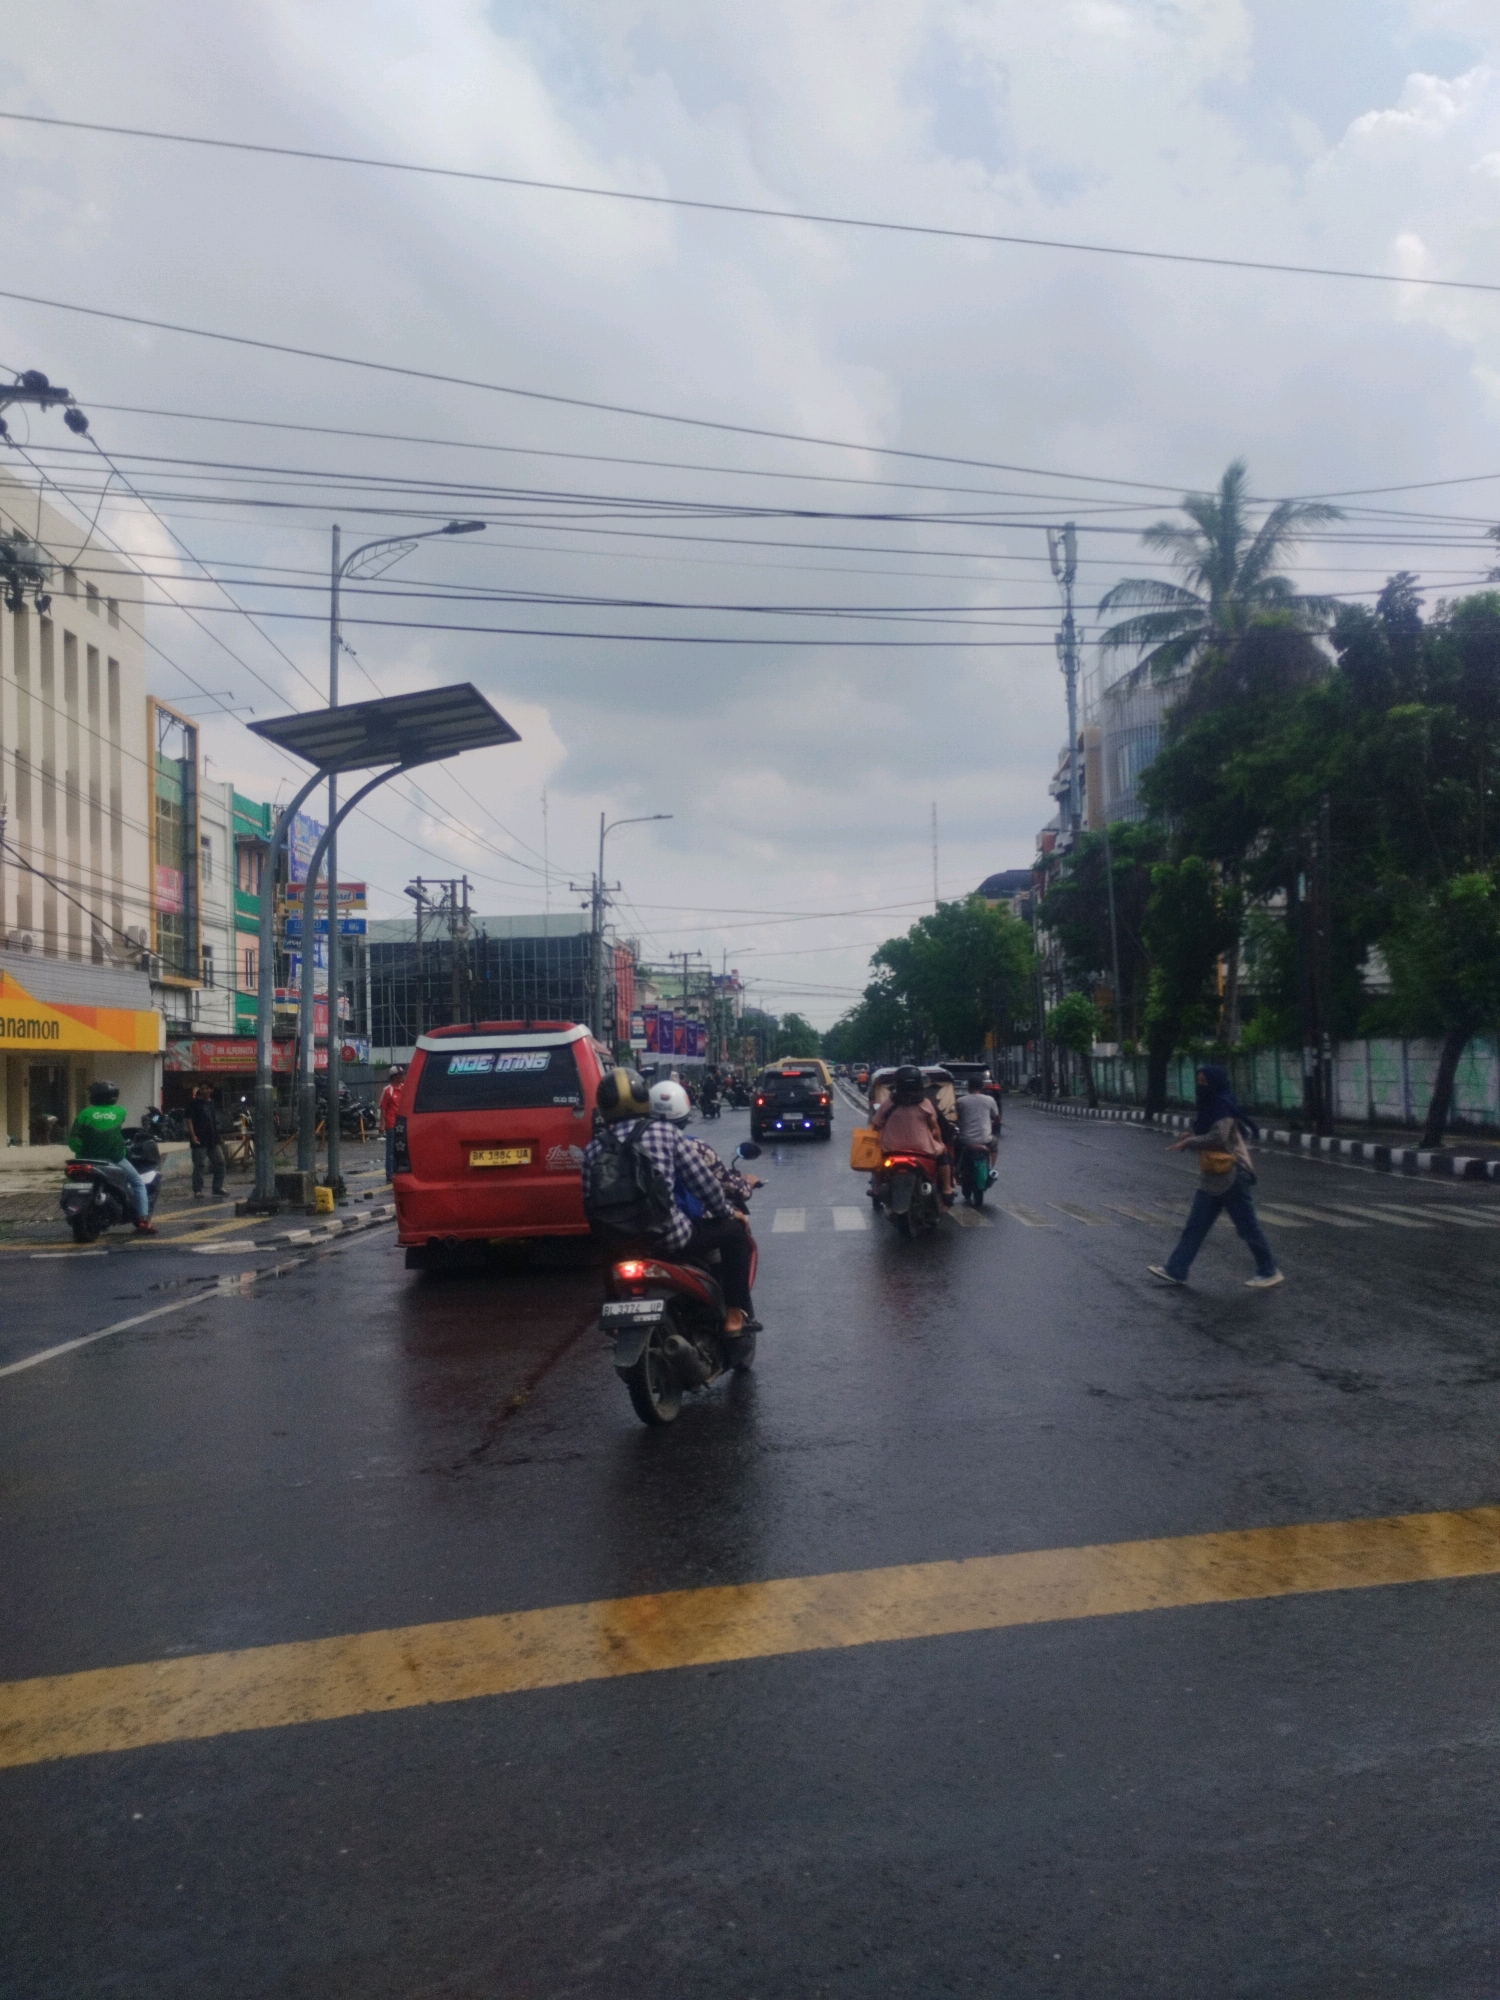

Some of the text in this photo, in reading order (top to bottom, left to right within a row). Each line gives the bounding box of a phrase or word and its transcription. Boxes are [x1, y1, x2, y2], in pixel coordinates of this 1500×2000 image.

[93, 1112, 117, 1120] Grab
[473, 1151, 484, 1160] BK
[517, 1149, 528, 1158] UA
